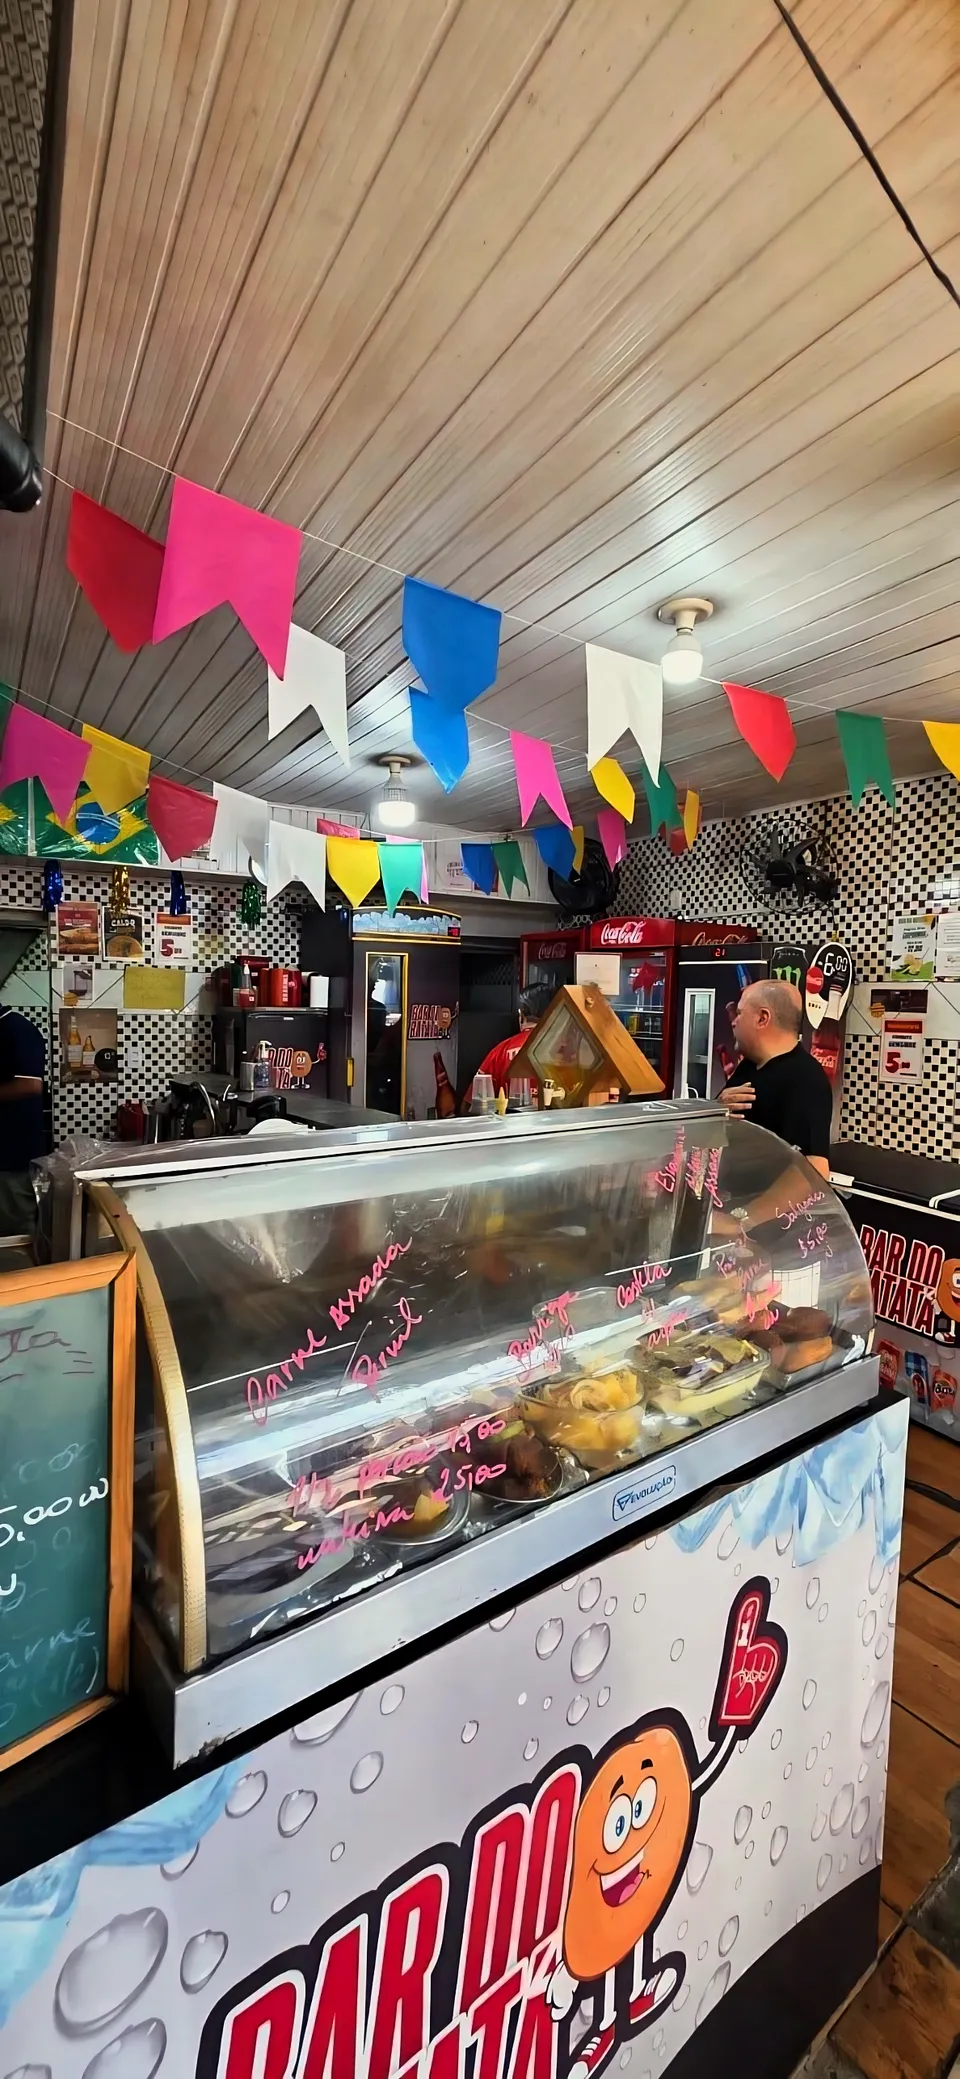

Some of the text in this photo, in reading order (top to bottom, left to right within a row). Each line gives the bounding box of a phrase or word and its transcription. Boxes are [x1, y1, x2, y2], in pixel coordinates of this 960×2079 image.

[859, 1223, 945, 1288] BAR DO
[869, 1267, 937, 1337] ATATA
[454, 1762, 582, 2016] DO
